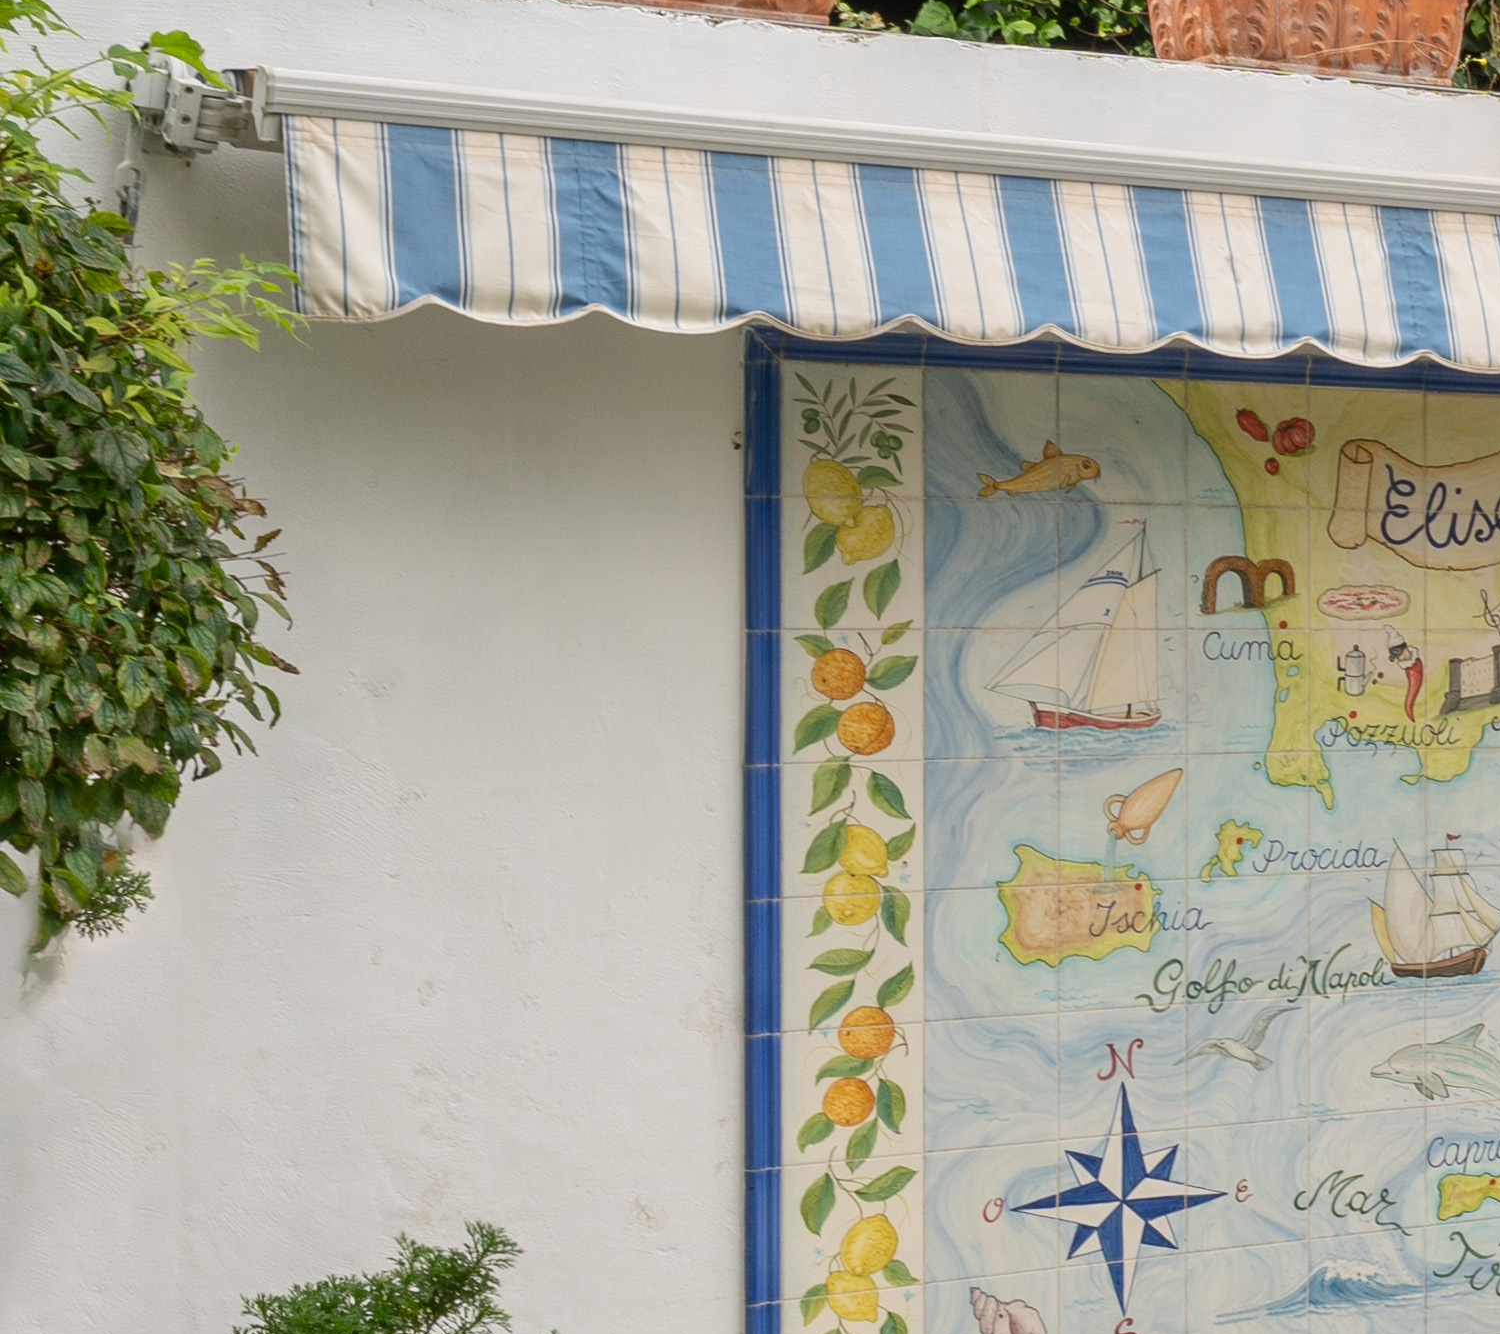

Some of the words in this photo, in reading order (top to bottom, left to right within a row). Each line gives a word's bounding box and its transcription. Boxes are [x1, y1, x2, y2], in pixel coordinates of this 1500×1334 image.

[1203, 632, 1304, 661] Cuma
[1322, 718, 1461, 757] Pozzuoli
[1252, 839, 1389, 873] Procida
[1089, 901, 1214, 937] Ischia
[1135, 958, 1265, 1014] Golfo
[1268, 966, 1298, 999] di
[1287, 944, 1397, 1004] Napoli
[1098, 1038, 1145, 1080] N
[982, 1198, 1004, 1223] O
[1294, 1170, 1413, 1236] Mar
